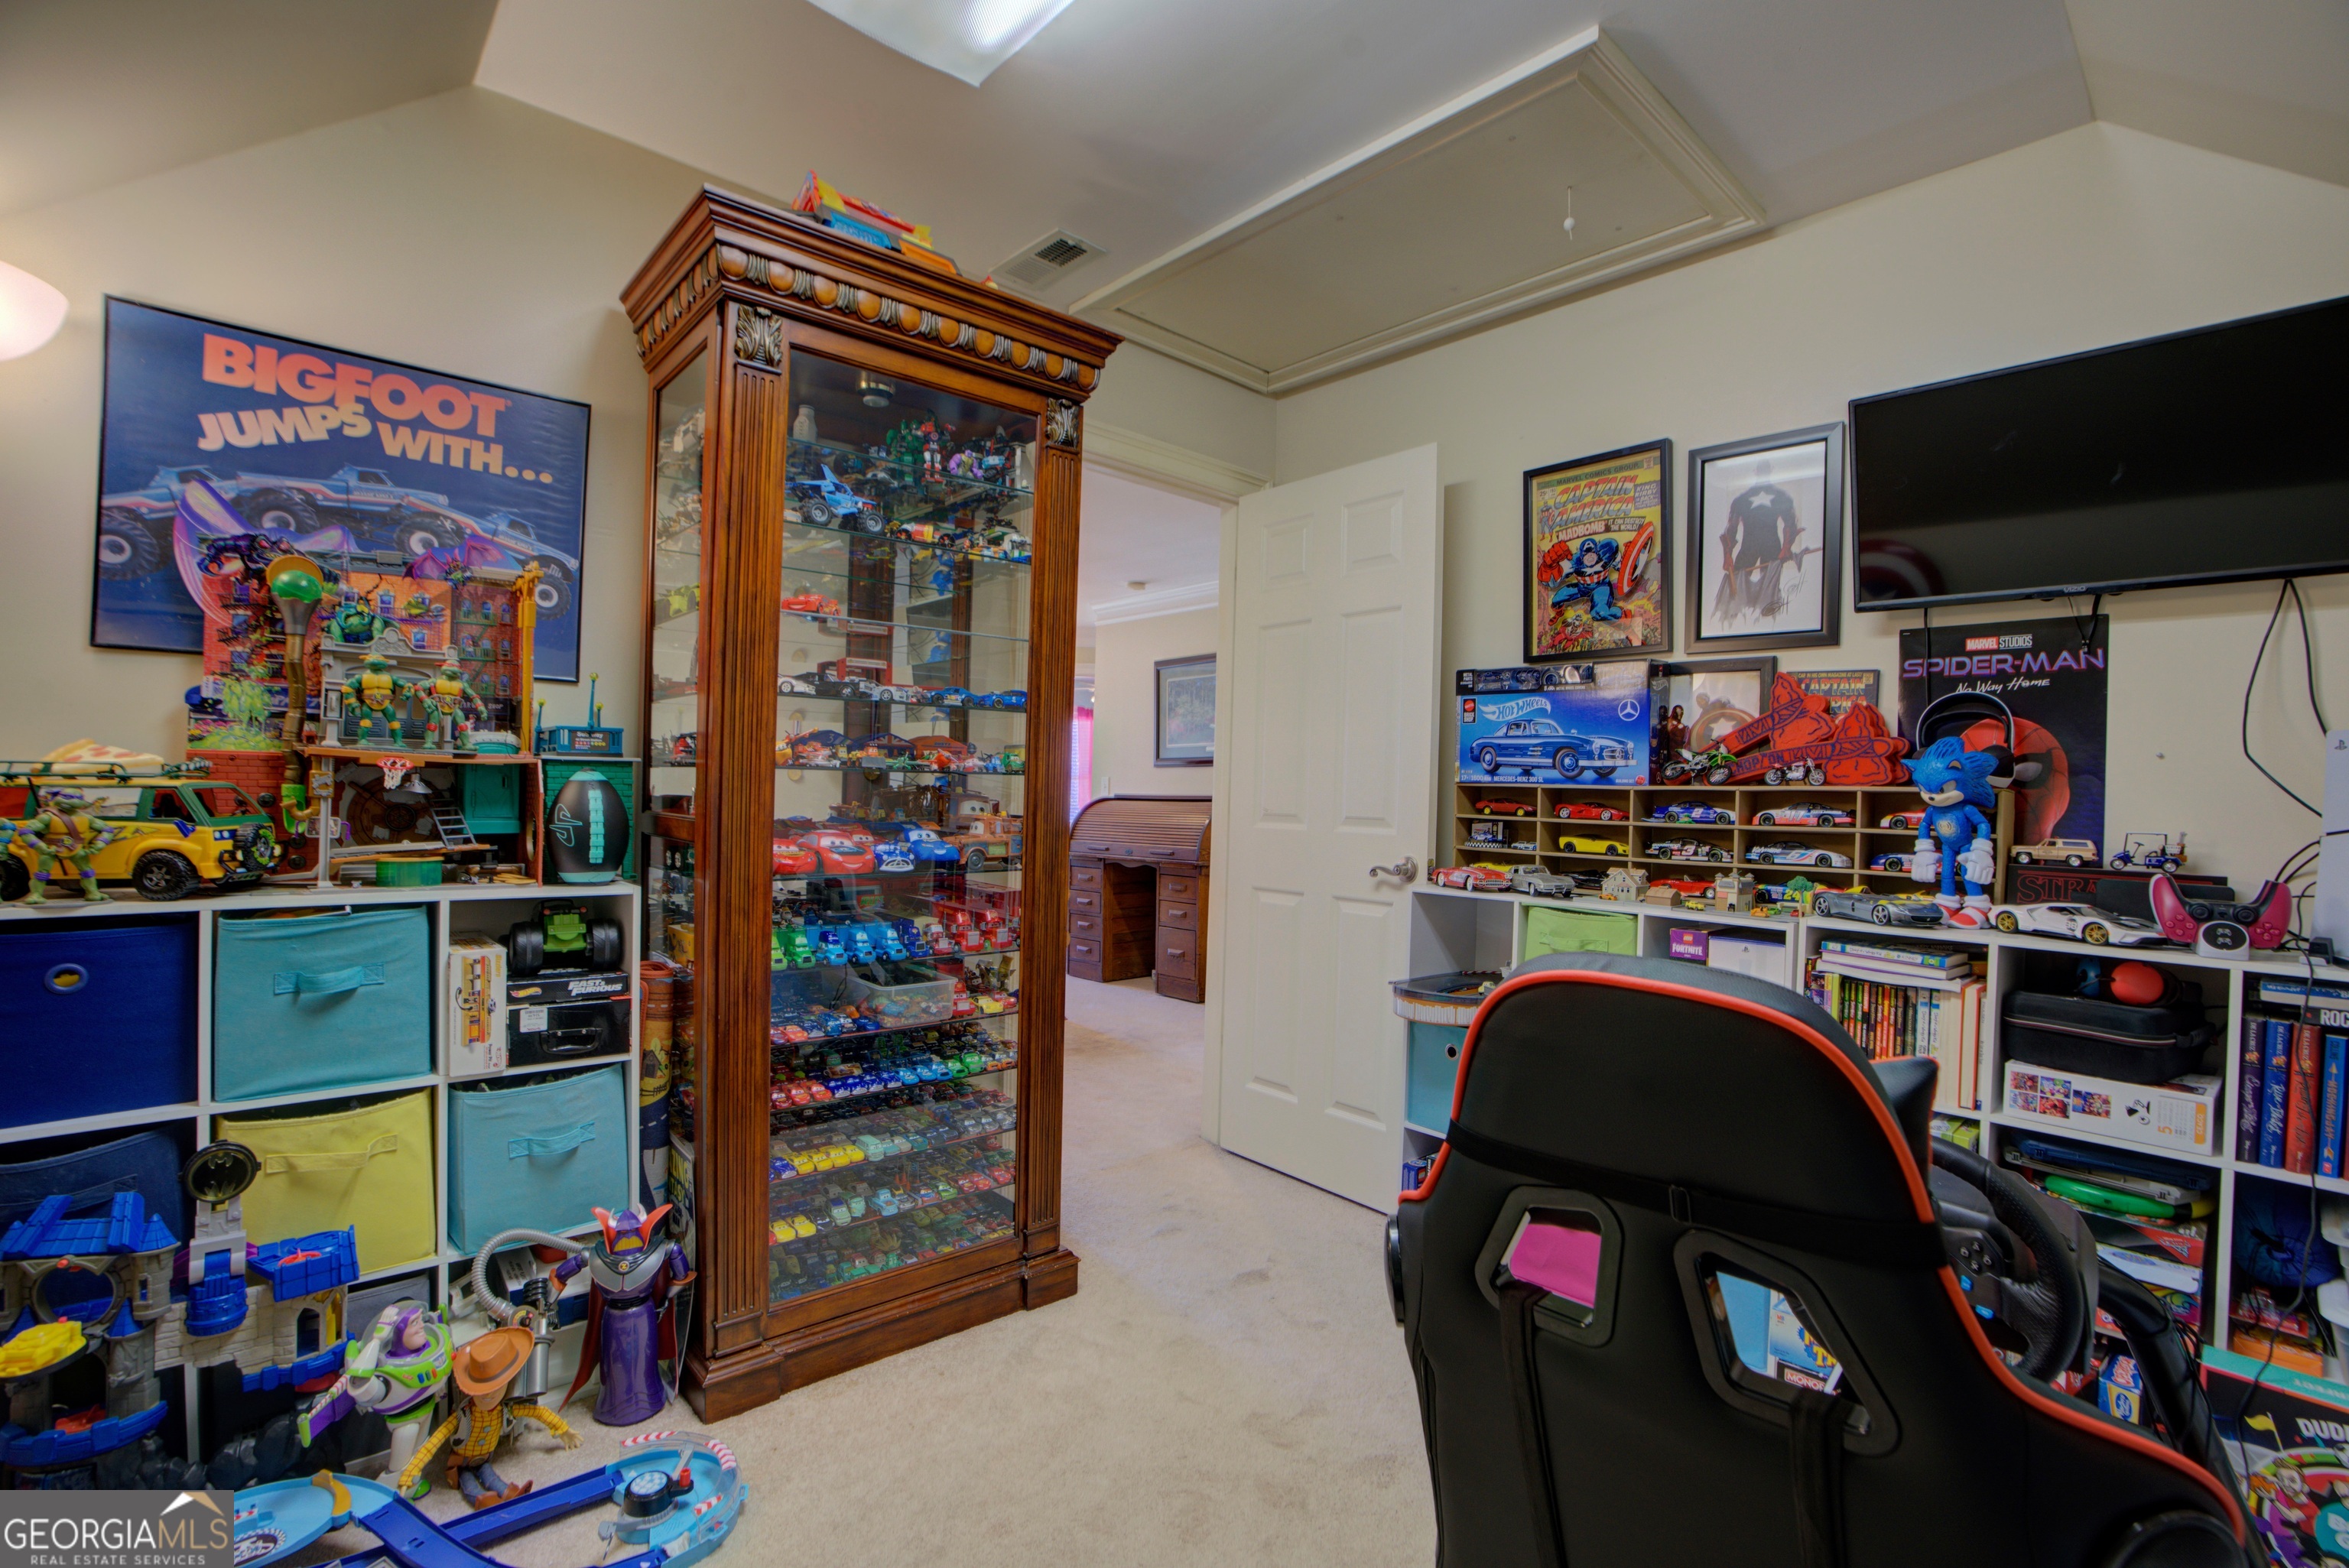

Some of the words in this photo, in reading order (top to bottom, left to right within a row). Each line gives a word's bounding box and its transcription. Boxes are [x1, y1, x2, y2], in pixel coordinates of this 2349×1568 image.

[203, 333, 505, 437] BIGFOOT
[197, 401, 372, 451] JUMPS
[376, 421, 554, 485] WITH...
[1557, 476, 1583, 486] MARVEL
[1584, 469, 1612, 480] COMICS
[1554, 475, 1639, 509] CAPTAIN
[1635, 488, 1658, 498] KIRBY
[1636, 483, 1657, 492] KING
[1550, 496, 1634, 530] AMERICA
[1624, 517, 1645, 525] DESTROY
[1967, 637, 1998, 651] MARVEL
[2000, 635, 2032, 649] STUDIOS
[1902, 648, 2104, 678] SPIDER-MAN
[1801, 677, 1867, 695] CAPTAIN
[1977, 680, 2003, 693] Way
[1498, 706, 1516, 719] HOT
[1681, 845, 1696, 855] 3
[1672, 943, 1703, 955] FORTNITE
[567, 979, 601, 990] FAST
[570, 984, 622, 996] FURIOUS
[2276, 1040, 2284, 1056] CRUZ
[2330, 1040, 2340, 1060] COLLINS
[2325, 1079, 2338, 1139] MOCKINGJAY
[2158, 1125, 2172, 1135] 5
